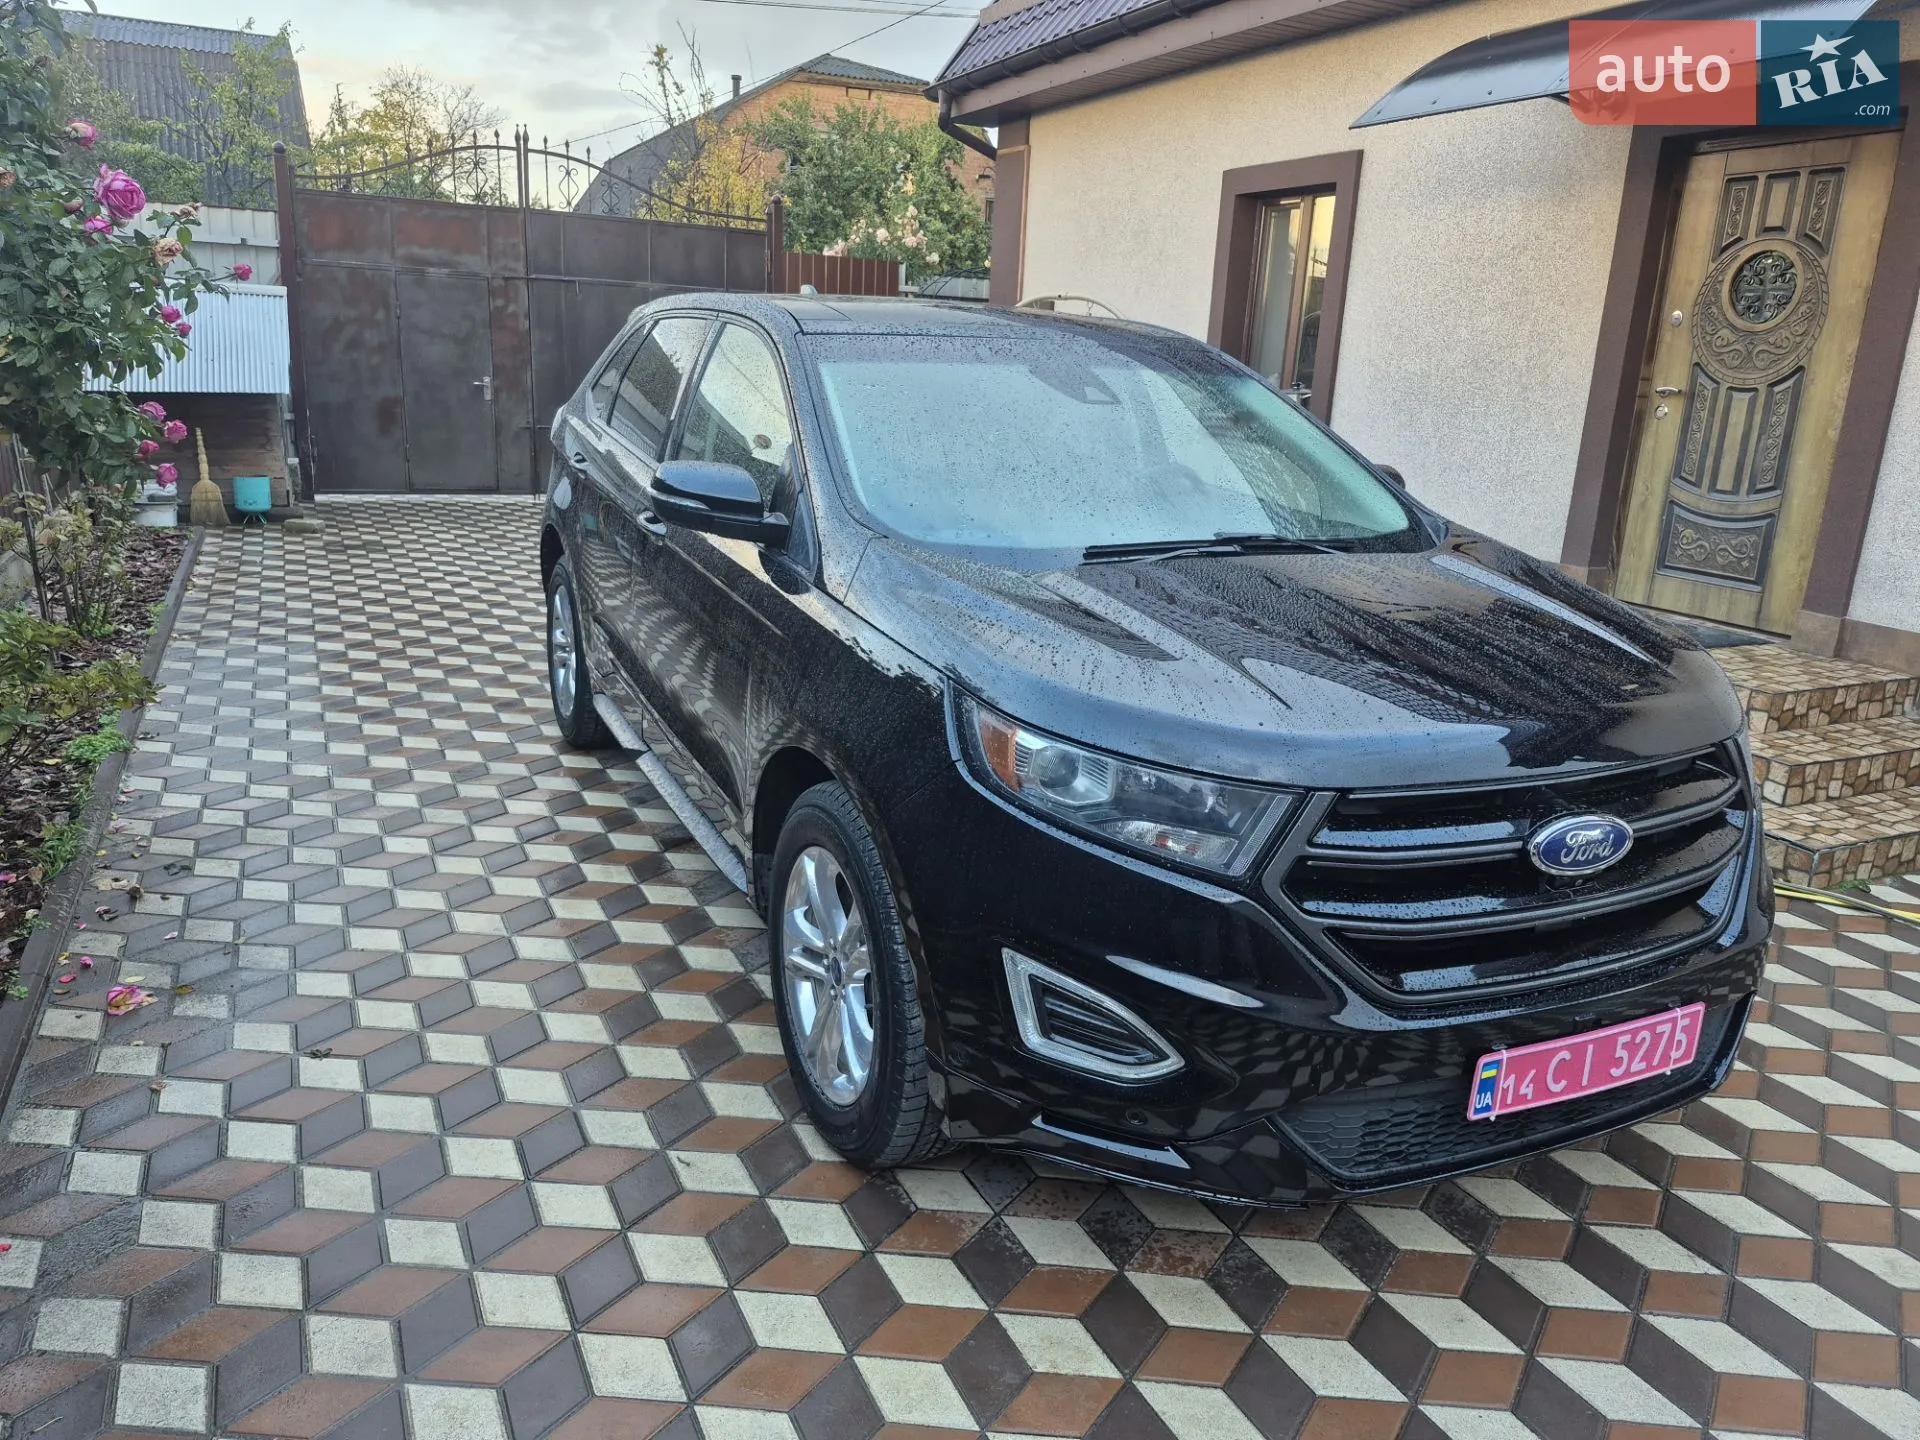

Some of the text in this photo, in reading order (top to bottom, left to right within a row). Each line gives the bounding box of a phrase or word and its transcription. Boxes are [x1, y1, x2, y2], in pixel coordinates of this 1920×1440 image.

[1560, 825, 1615, 864] Ford
[1502, 1069, 1537, 1105] 14
[1609, 1018, 1691, 1078] 5275
[1475, 1091, 1493, 1109] UA
